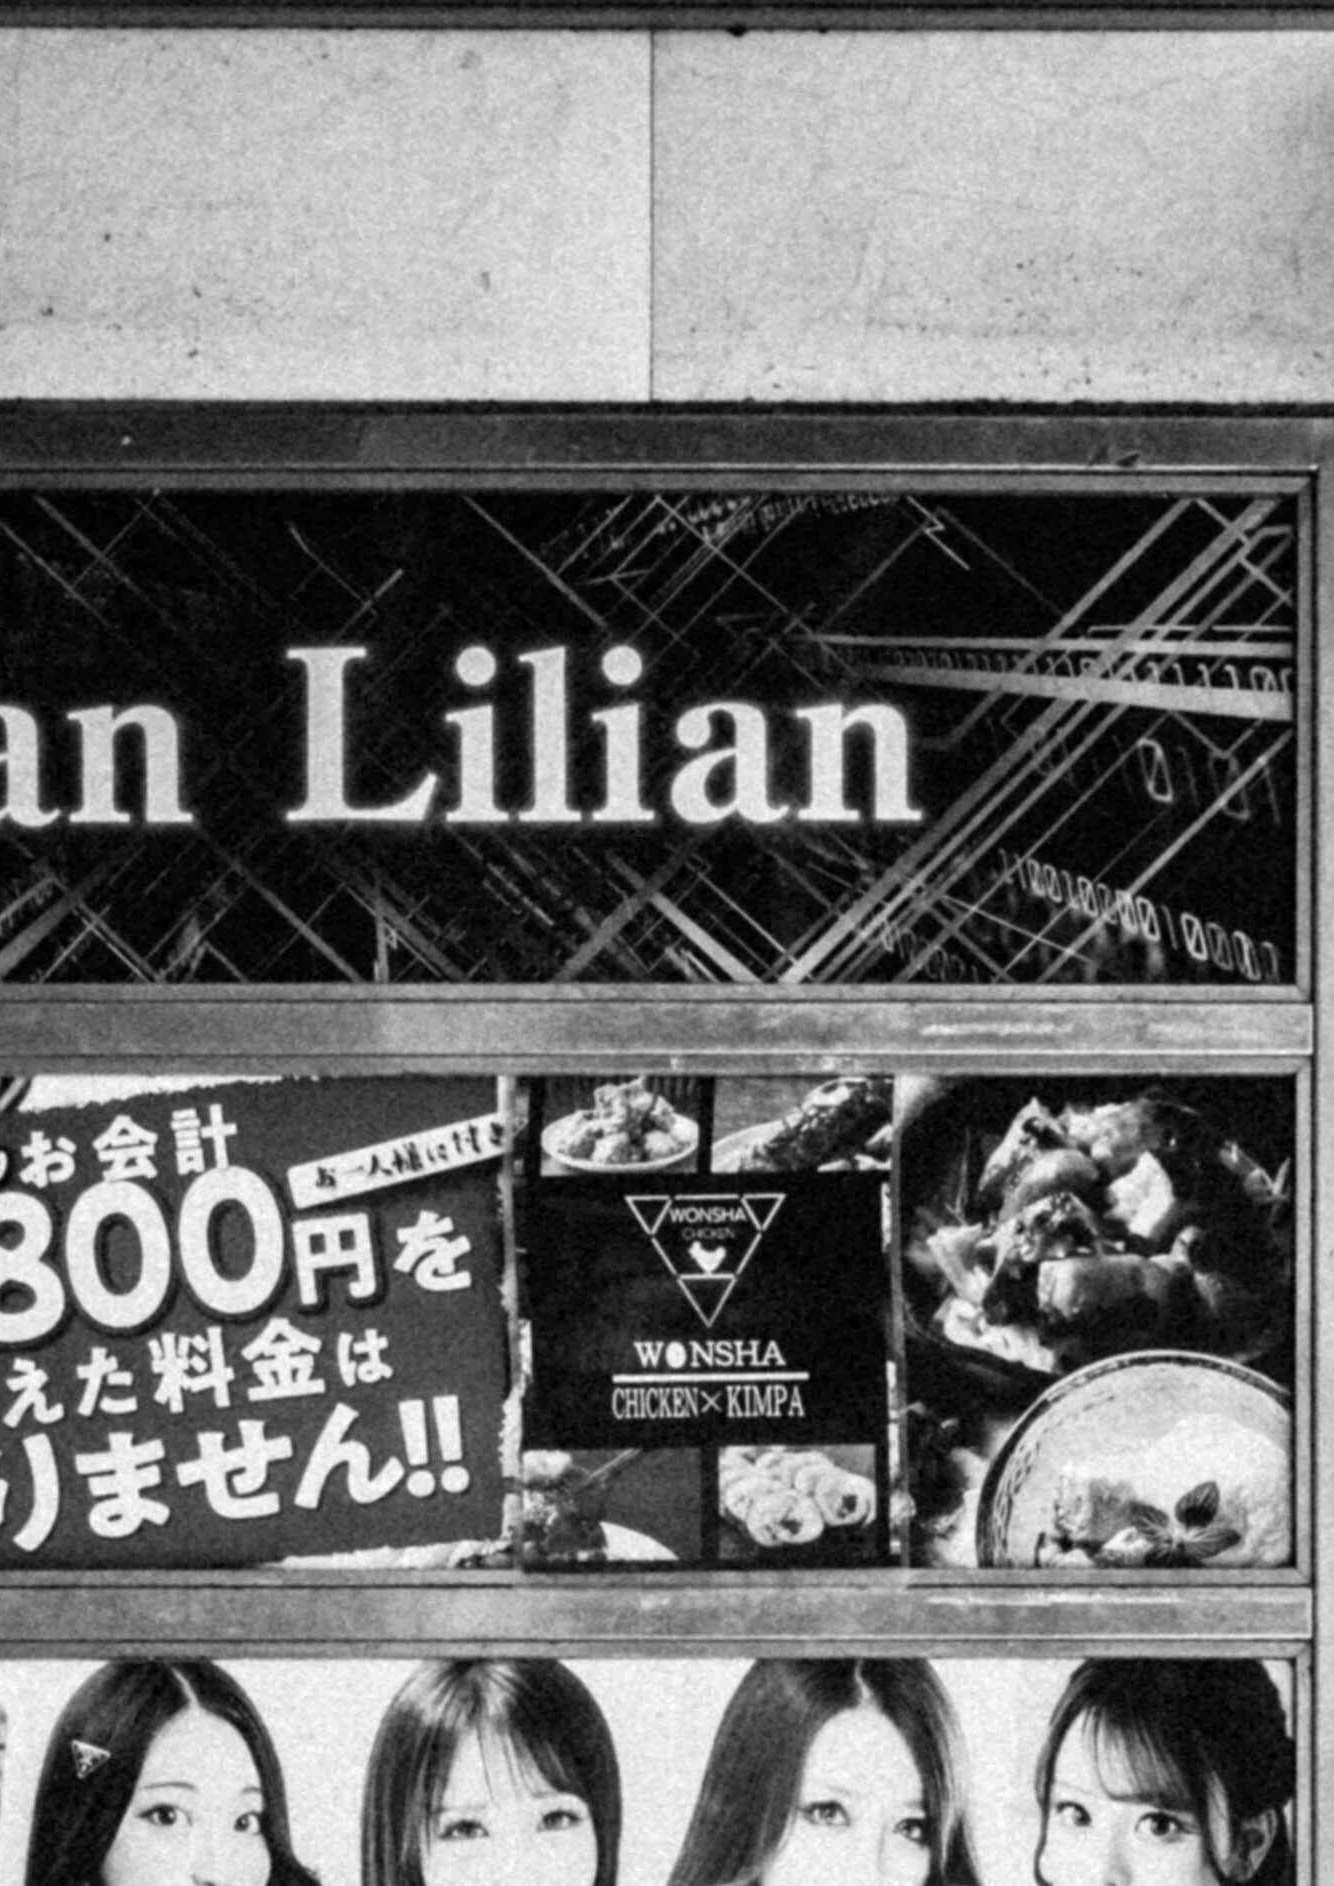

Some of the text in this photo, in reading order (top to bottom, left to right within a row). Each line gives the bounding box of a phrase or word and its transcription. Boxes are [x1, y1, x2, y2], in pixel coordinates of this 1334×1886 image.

[286, 645, 922, 824] Lilian
[20, 1104, 239, 1189] お会計
[669, 1206, 747, 1225] WONSHA
